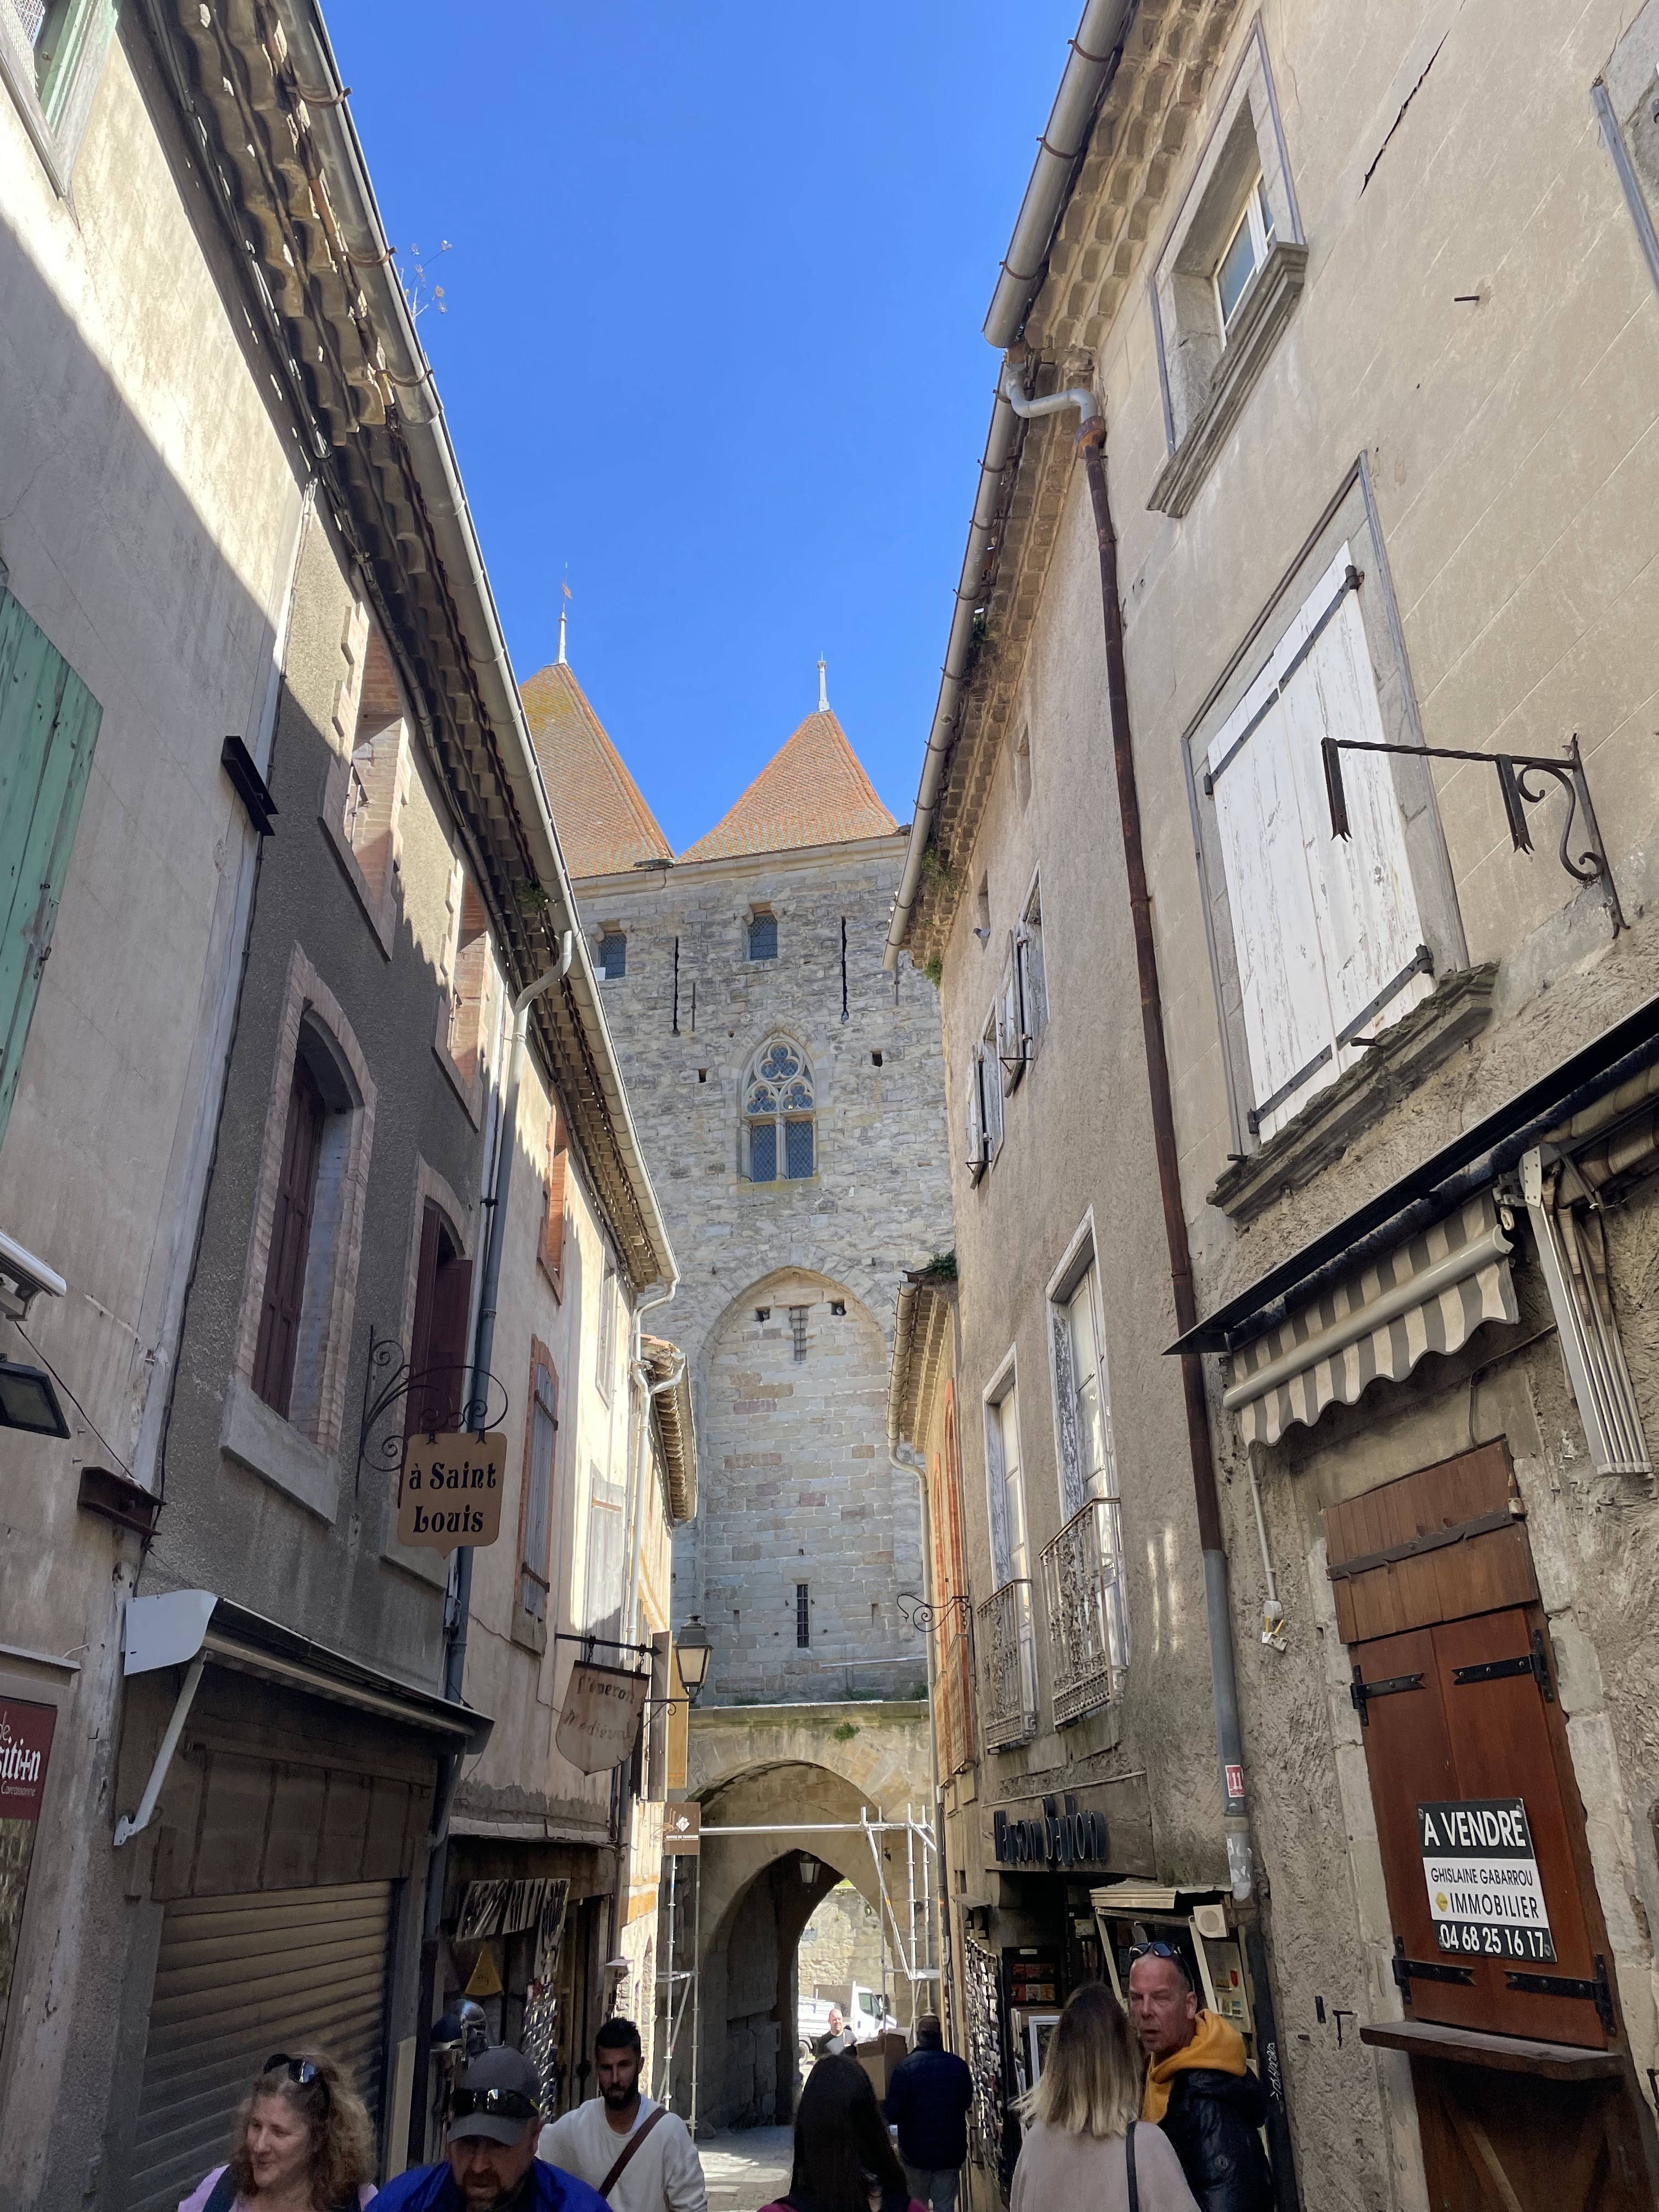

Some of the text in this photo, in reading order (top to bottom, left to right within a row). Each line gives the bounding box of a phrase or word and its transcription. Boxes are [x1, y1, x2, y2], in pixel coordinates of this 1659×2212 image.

[409, 1461, 496, 1489] à Saint
[413, 1504, 483, 1533] Louis
[1440, 1810, 1526, 1847] VENDRE
[1431, 1867, 1533, 1886] GHISLAINE GABARROU
[1449, 1893, 1539, 1919] IMMOBILIER
[1440, 1924, 1544, 1957] 04 68 25 16 17
